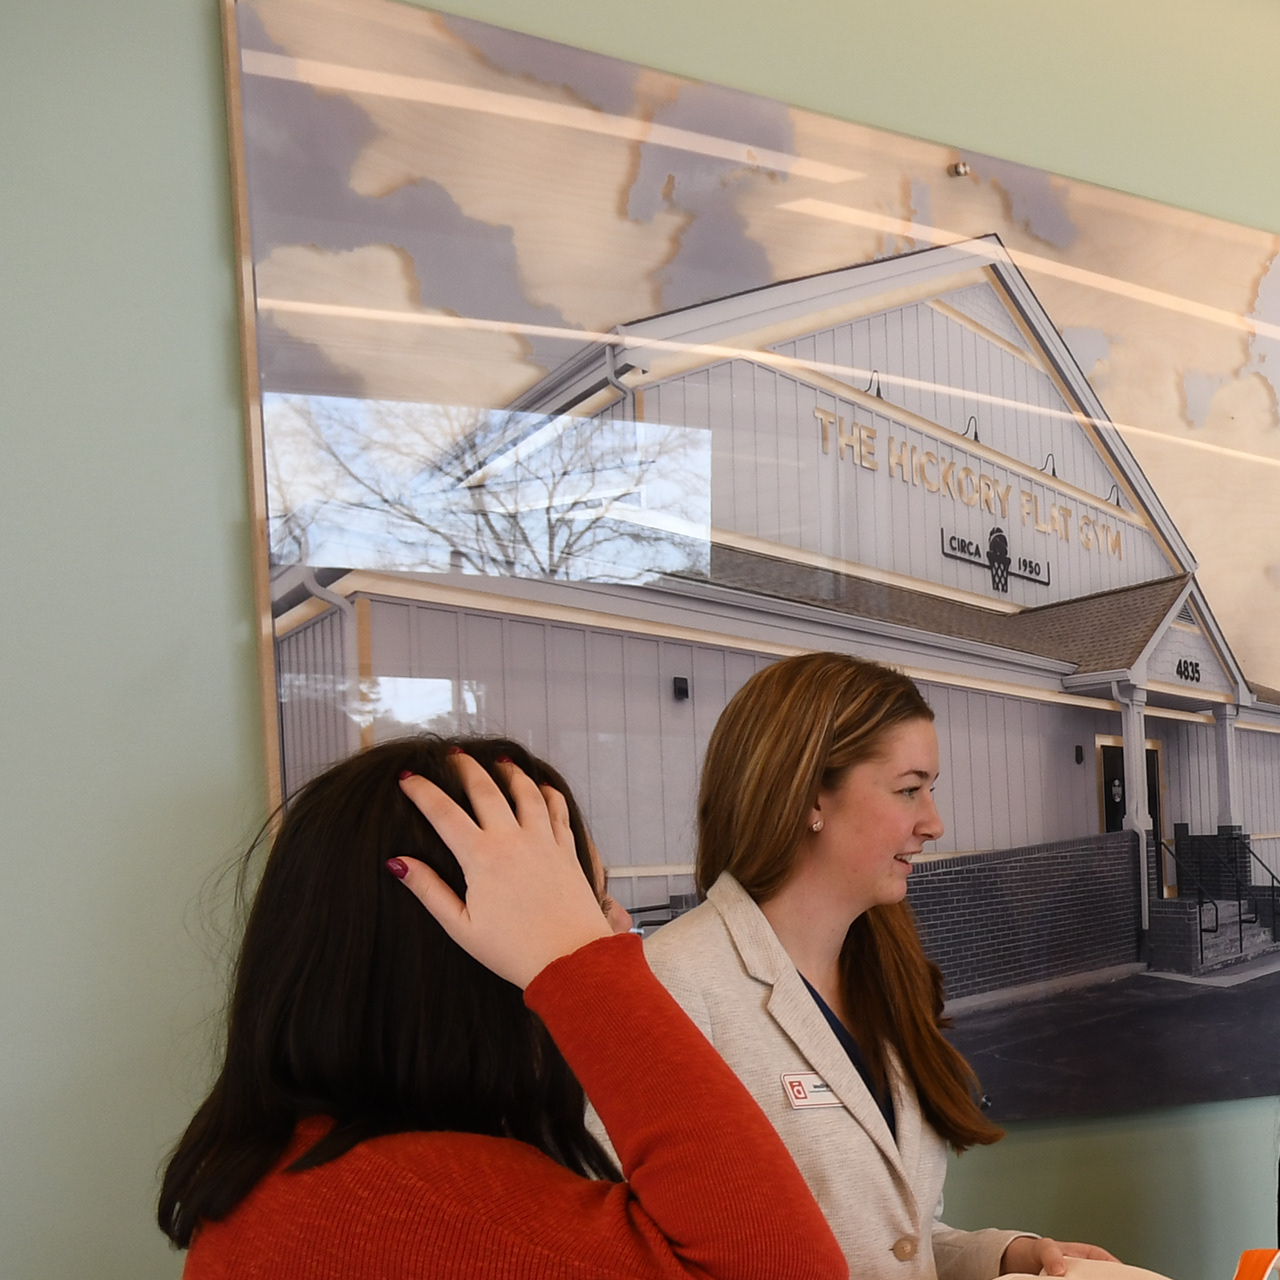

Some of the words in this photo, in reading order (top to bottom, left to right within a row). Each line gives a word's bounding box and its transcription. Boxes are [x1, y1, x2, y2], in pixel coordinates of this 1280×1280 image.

[813, 407, 879, 473] THE
[888, 436, 1012, 519] HICKORY
[1020, 491, 1072, 544] FLAT
[1079, 514, 1124, 562] GYM
[949, 535, 982, 559] CIRCA
[1017, 557, 1042, 577] 1950
[1176, 658, 1202, 683] 4835
